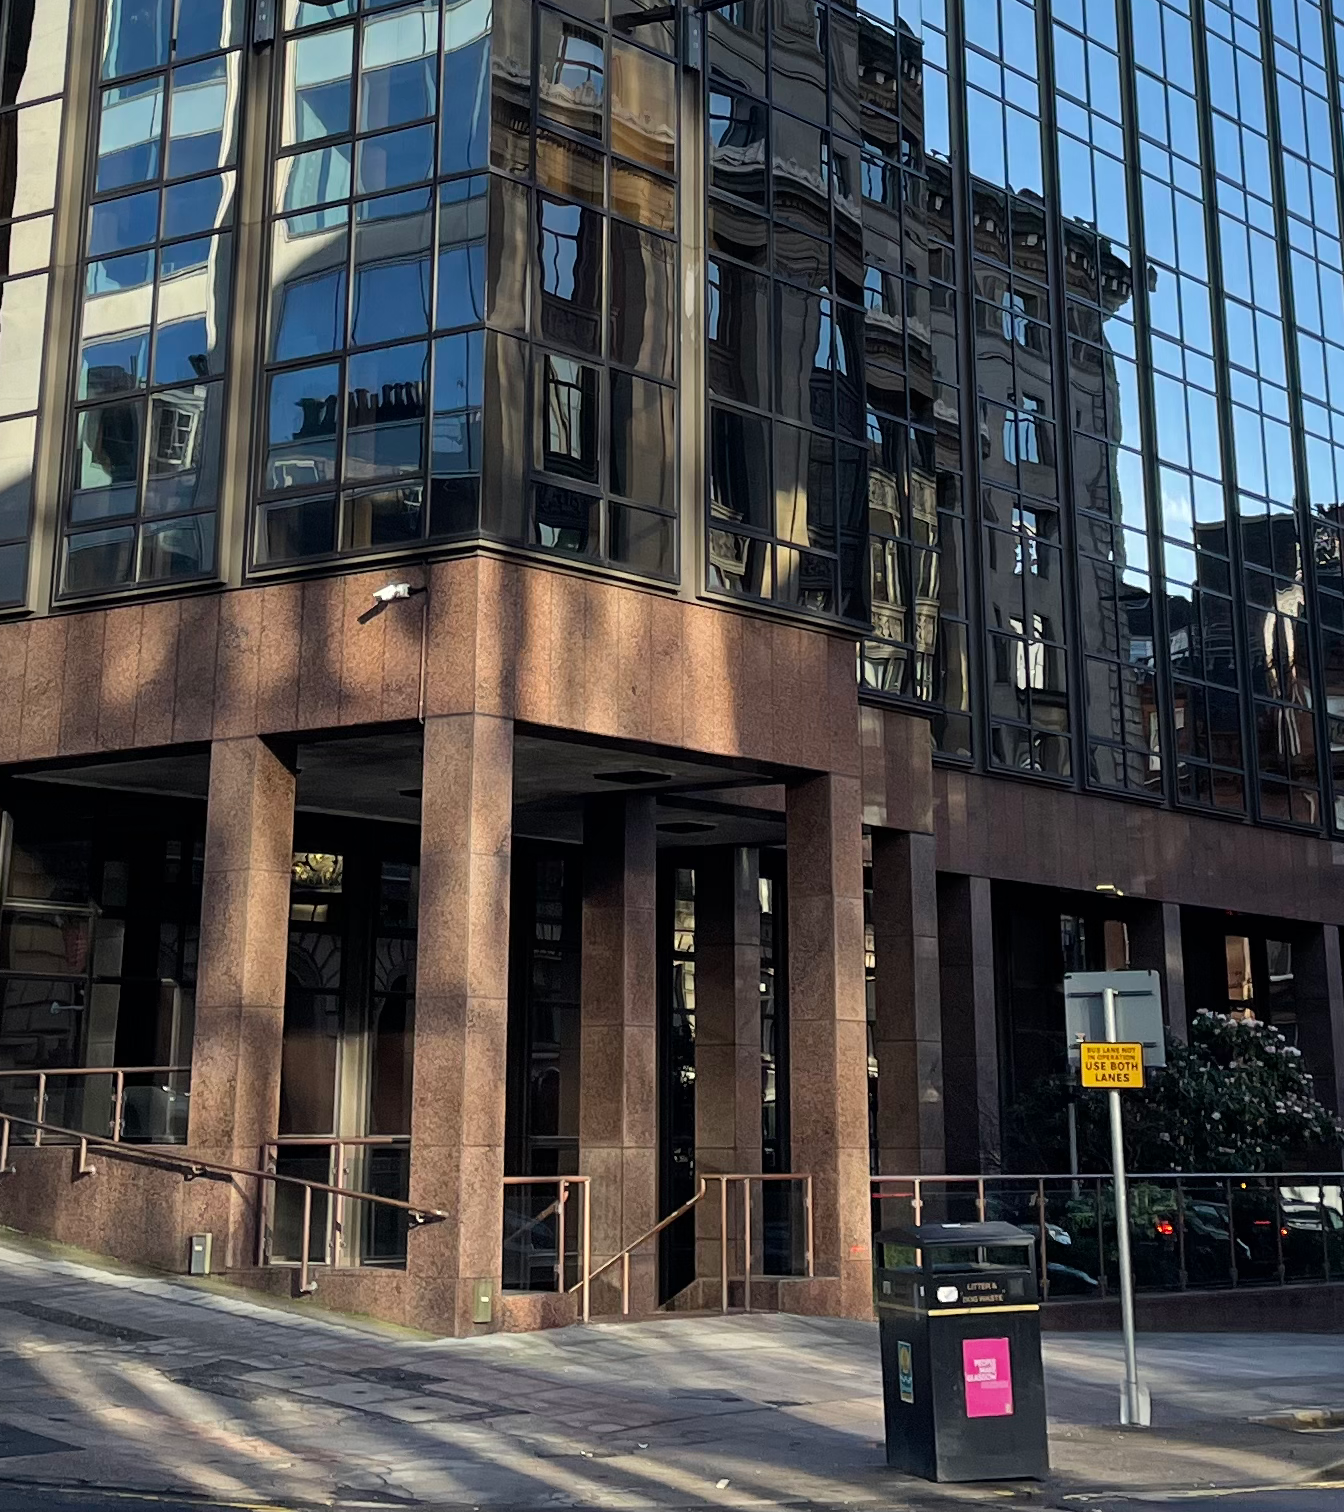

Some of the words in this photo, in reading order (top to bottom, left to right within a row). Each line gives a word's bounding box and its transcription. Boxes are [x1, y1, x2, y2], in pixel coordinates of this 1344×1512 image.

[1085, 1061, 1106, 1071] USE
[1110, 1061, 1139, 1072] BOTH
[1095, 1073, 1130, 1083] LANES
